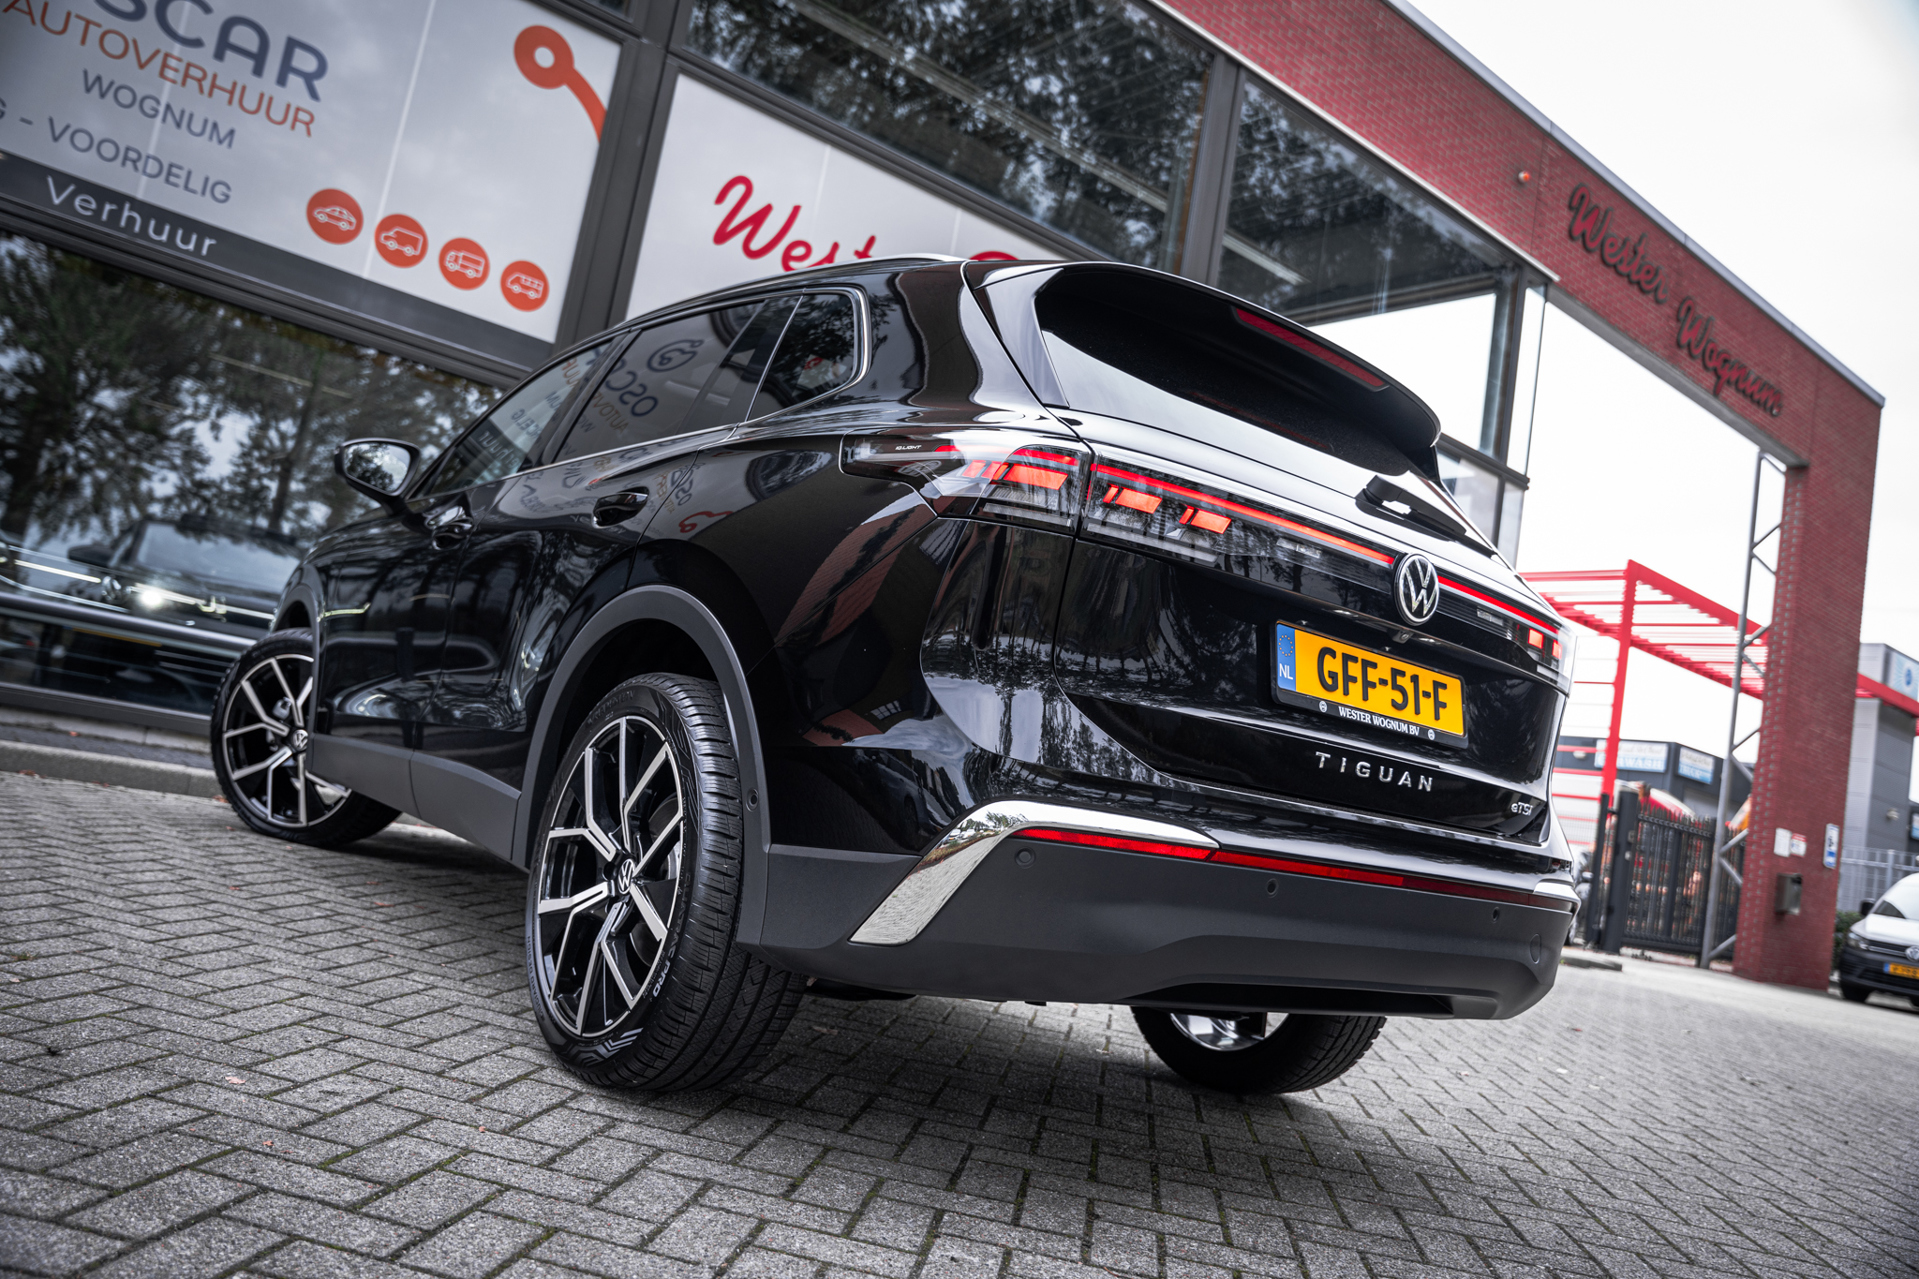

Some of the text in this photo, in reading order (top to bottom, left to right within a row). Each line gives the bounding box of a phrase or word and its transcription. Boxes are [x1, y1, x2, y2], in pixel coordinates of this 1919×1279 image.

[2, 0, 315, 137] AUTOVERHUUR
[82, 68, 236, 149] WOGNUM
[48, 116, 232, 204] VOORDELIG
[47, 175, 217, 256] Verhuur
[1568, 183, 1783, 417] Wester Wognum
[1279, 646, 1448, 721] NL GFF-51-F
[1338, 706, 1420, 736] WESTER WOGNUM BV
[1315, 751, 1433, 792] TIGUAN
[652, 959, 671, 997] PRO
